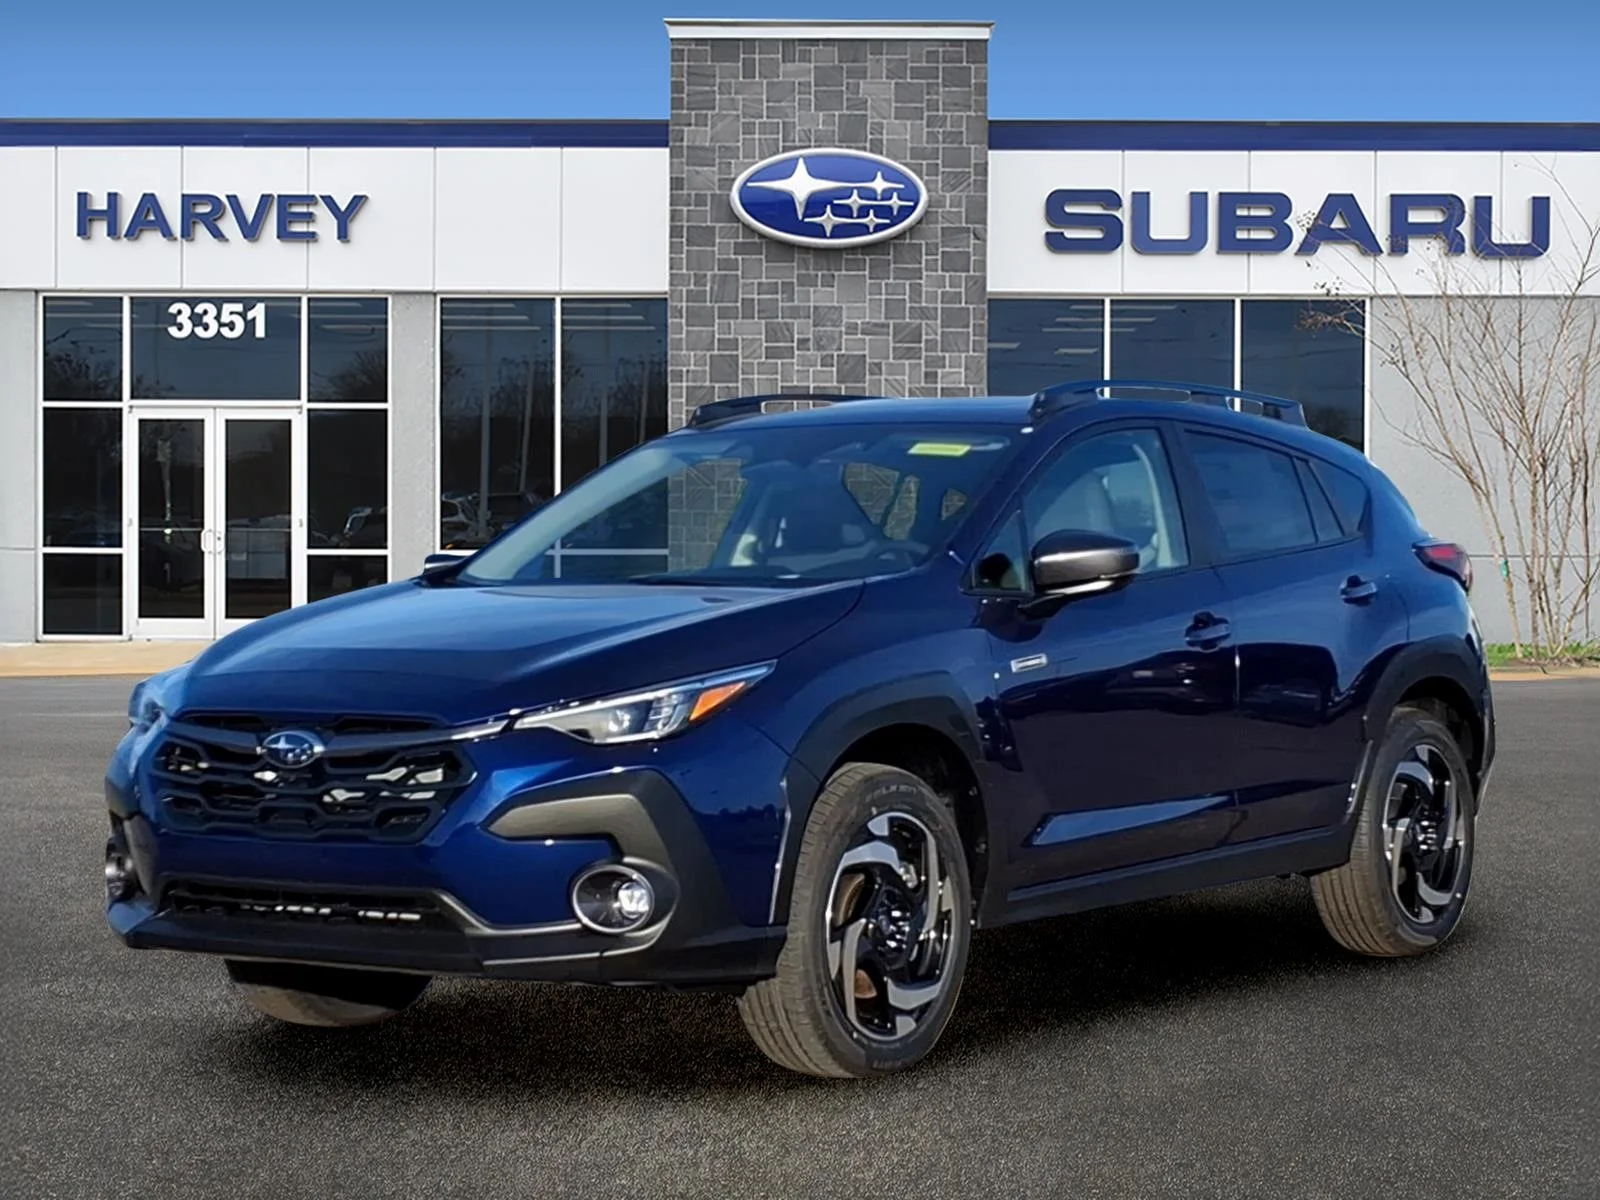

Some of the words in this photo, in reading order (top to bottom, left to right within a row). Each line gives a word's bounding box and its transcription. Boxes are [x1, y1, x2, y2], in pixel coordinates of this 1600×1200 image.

[76, 191, 368, 242] HARVEY
[1044, 188, 1551, 259] SUBARU
[166, 302, 266, 339] 3351
